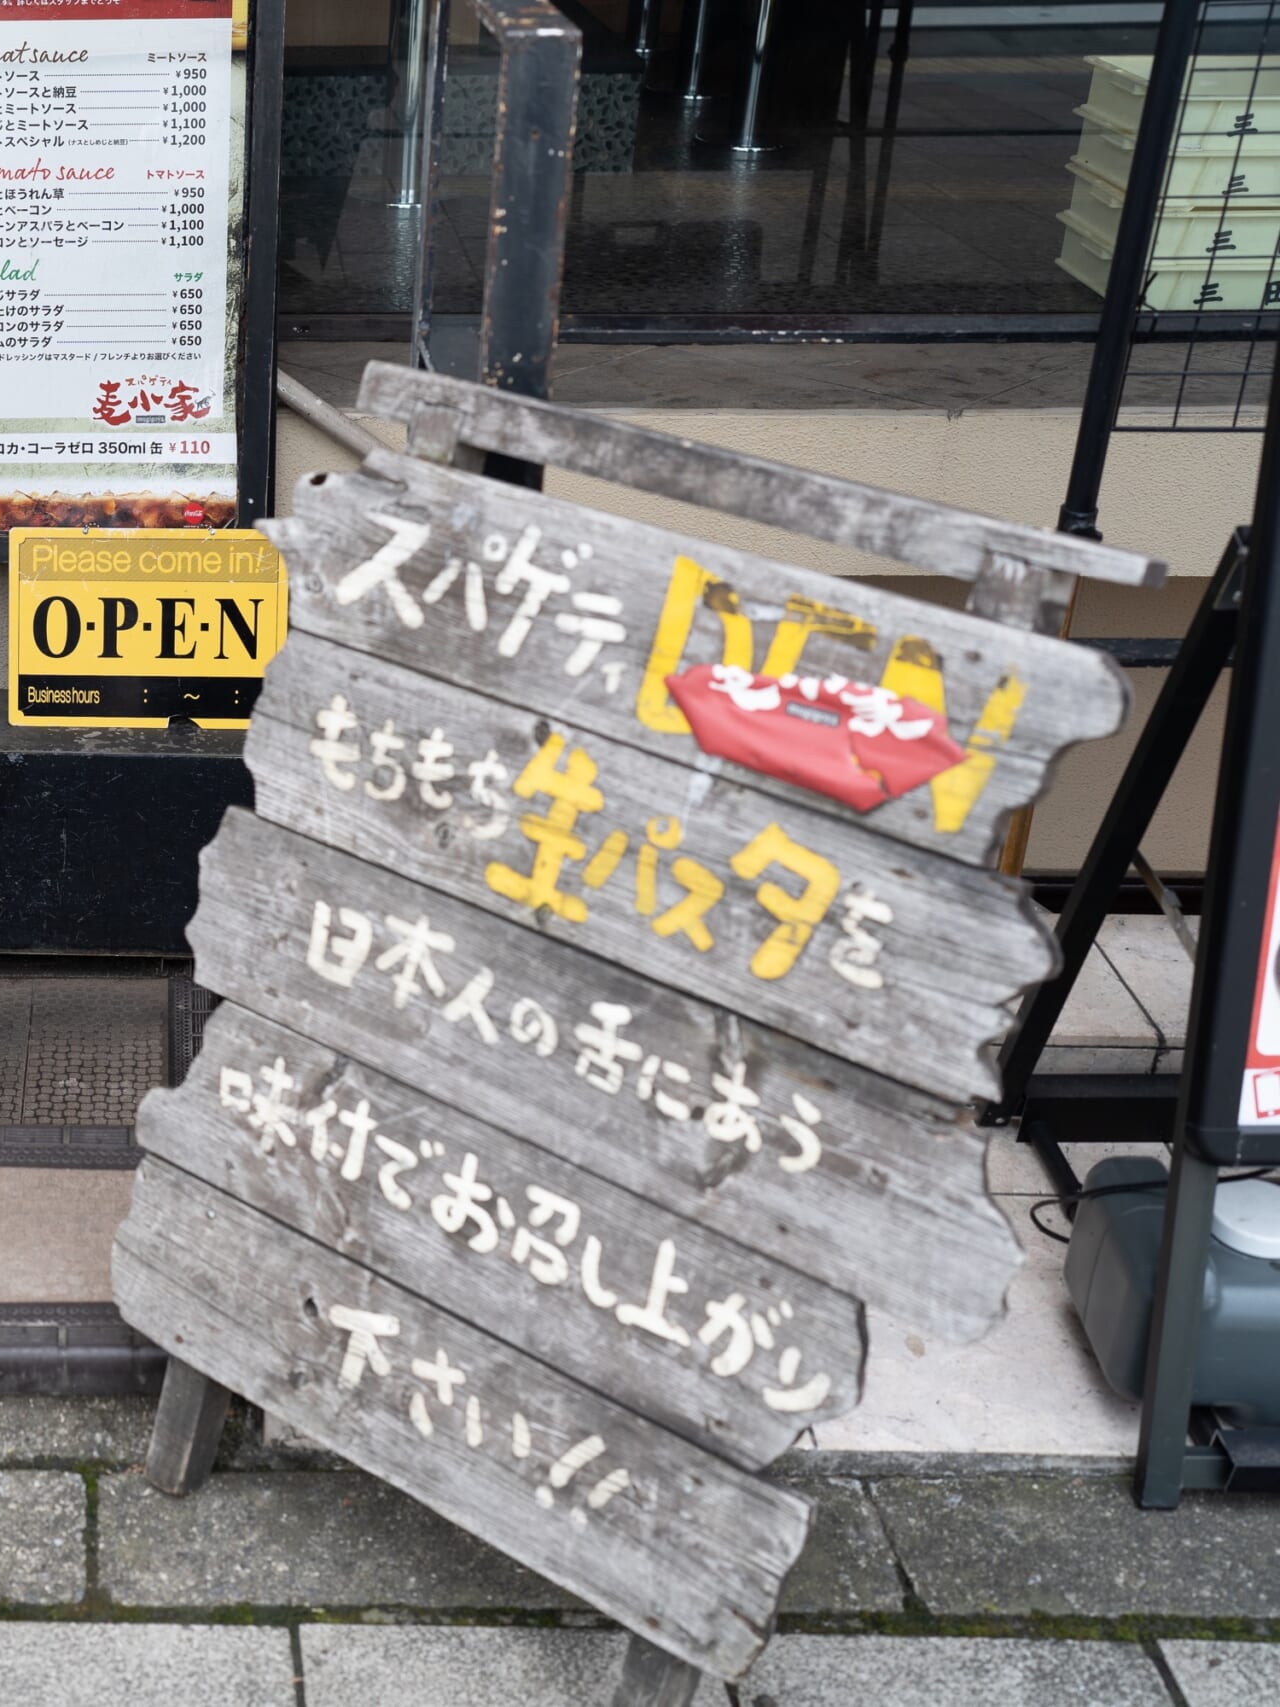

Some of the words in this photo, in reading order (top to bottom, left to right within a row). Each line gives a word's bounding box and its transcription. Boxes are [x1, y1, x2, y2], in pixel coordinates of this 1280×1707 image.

[147, 52, 208, 63] ミートソース
[175, 68, 207, 80] ¥950
[163, 85, 207, 97] ¥1,000
[163, 101, 207, 114] ¥1,000
[163, 118, 206, 130] ¥1,100
[163, 134, 206, 147] ¥1,200
[56, 165, 115, 181] sauce
[146, 168, 205, 180] トマトソース
[174, 187, 205, 199] ¥950
[161, 203, 205, 216] ¥1,000
[161, 219, 204, 232] ¥1,100
[161, 235, 204, 248] ¥1,100
[174, 271, 203, 283] サラダ
[172, 288, 203, 300] ¥650
[172, 304, 202, 316] ¥650
[172, 320, 202, 332] ¥650
[172, 335, 202, 348] ¥650
[93, 380, 211, 426] 麦小家
[98, 441, 146, 455] 350ml
[151, 441, 163, 455] 缶
[169, 440, 210, 455] ¥110
[32, 545, 131, 573] Please
[138, 551, 221, 573] come
[229, 546, 264, 573] in!
[336, 511, 626, 694] スパゲティ
[307, 900, 822, 1172] 日本人の舌にあう
[218, 1057, 831, 1412] 味付でお召し上がり
